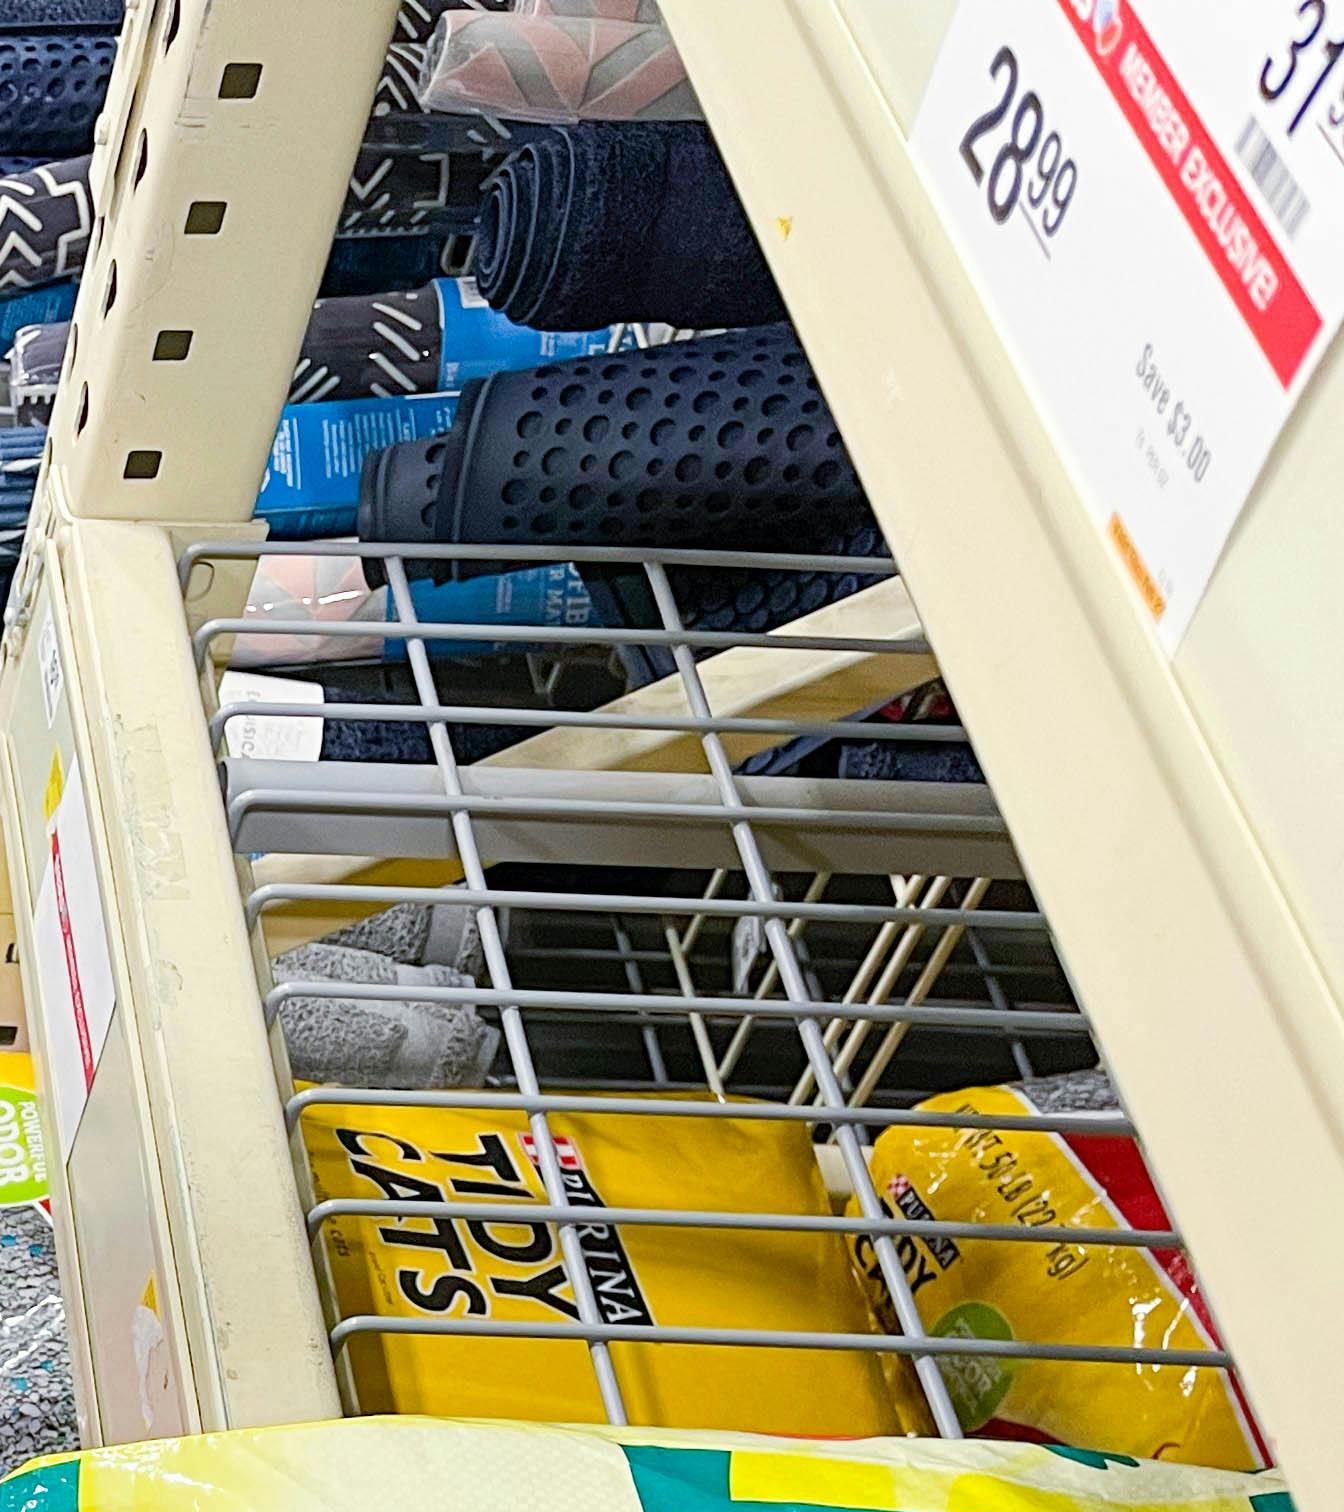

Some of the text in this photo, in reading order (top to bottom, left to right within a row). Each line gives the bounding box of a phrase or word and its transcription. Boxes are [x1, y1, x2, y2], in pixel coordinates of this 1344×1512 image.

[1118, 41, 1191, 166] MEMBER
[1135, 343, 1171, 416] Save
[1167, 397, 1212, 485] $3.00
[334, 1127, 489, 1318] CATS
